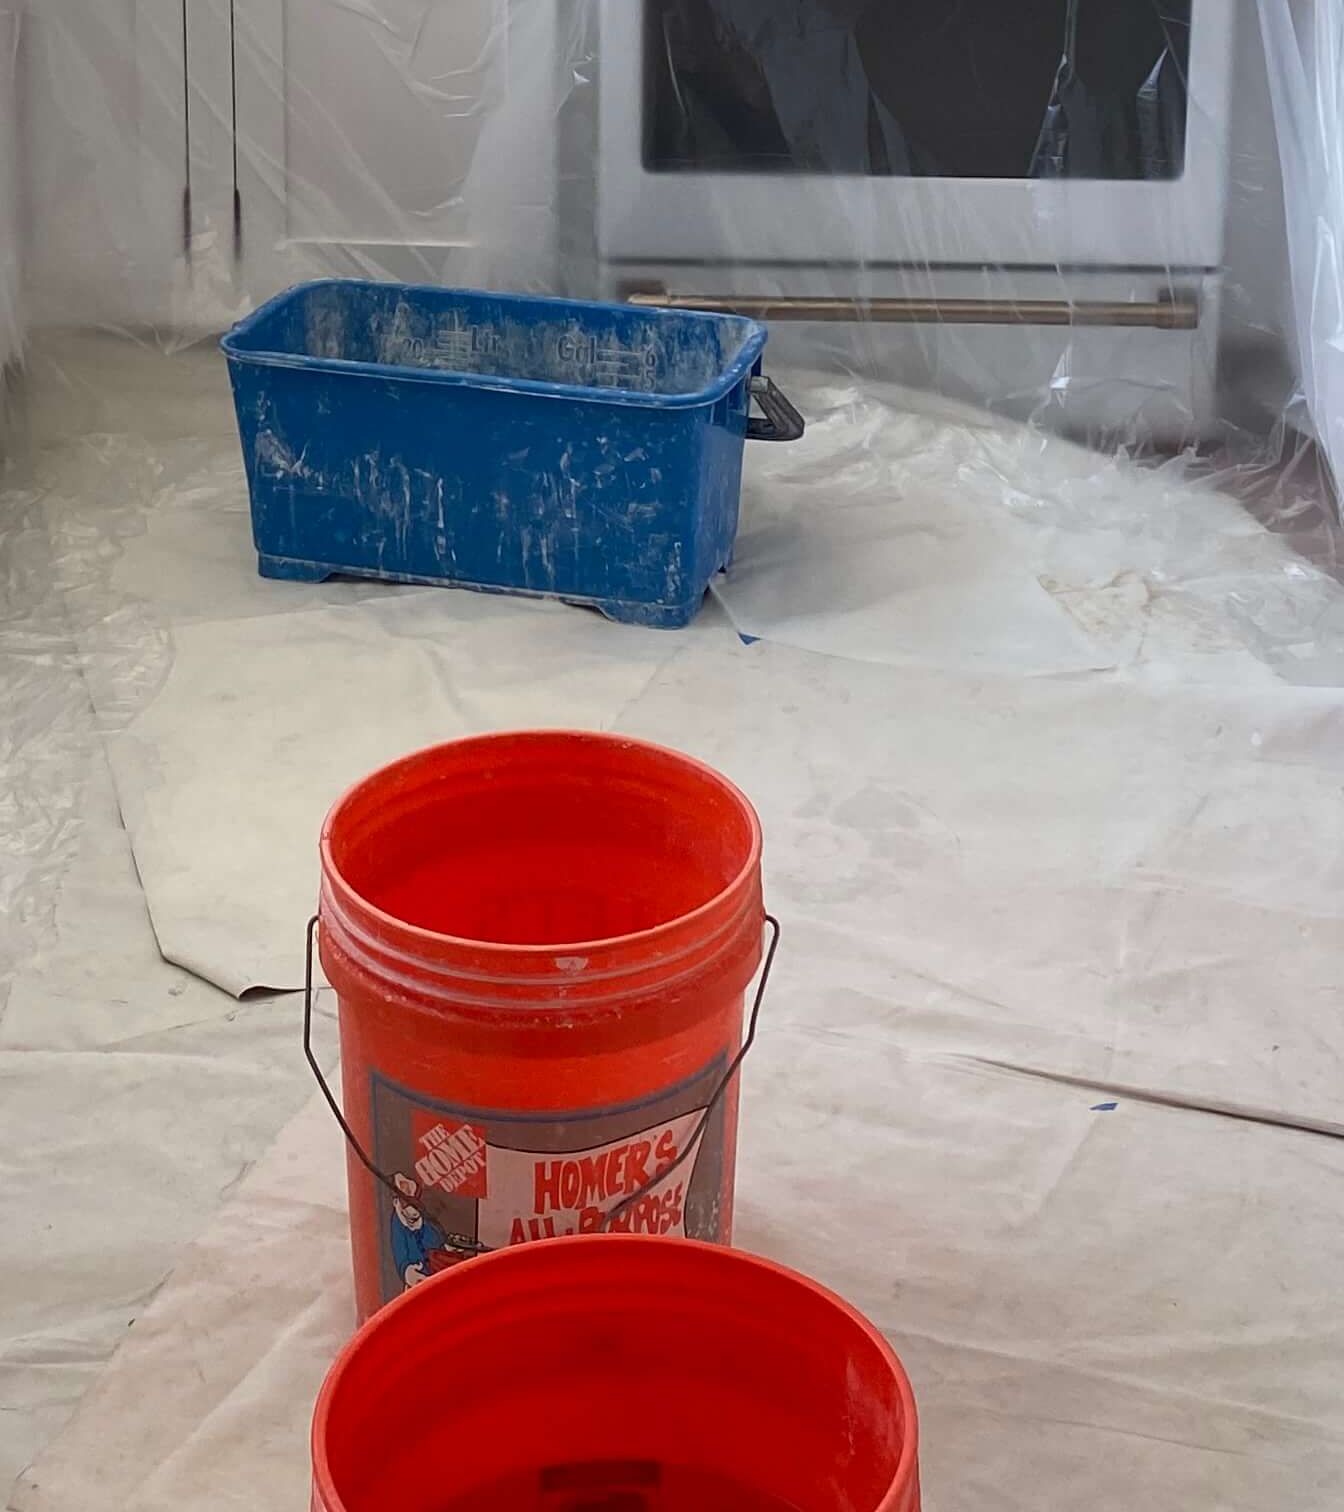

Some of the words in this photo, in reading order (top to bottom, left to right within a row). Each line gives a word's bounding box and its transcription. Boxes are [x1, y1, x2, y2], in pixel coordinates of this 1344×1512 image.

[415, 1124, 485, 1186] HOME
[419, 1123, 450, 1150] THE
[439, 1151, 485, 1192] DEPOT
[534, 1129, 678, 1214] HOMER'S
